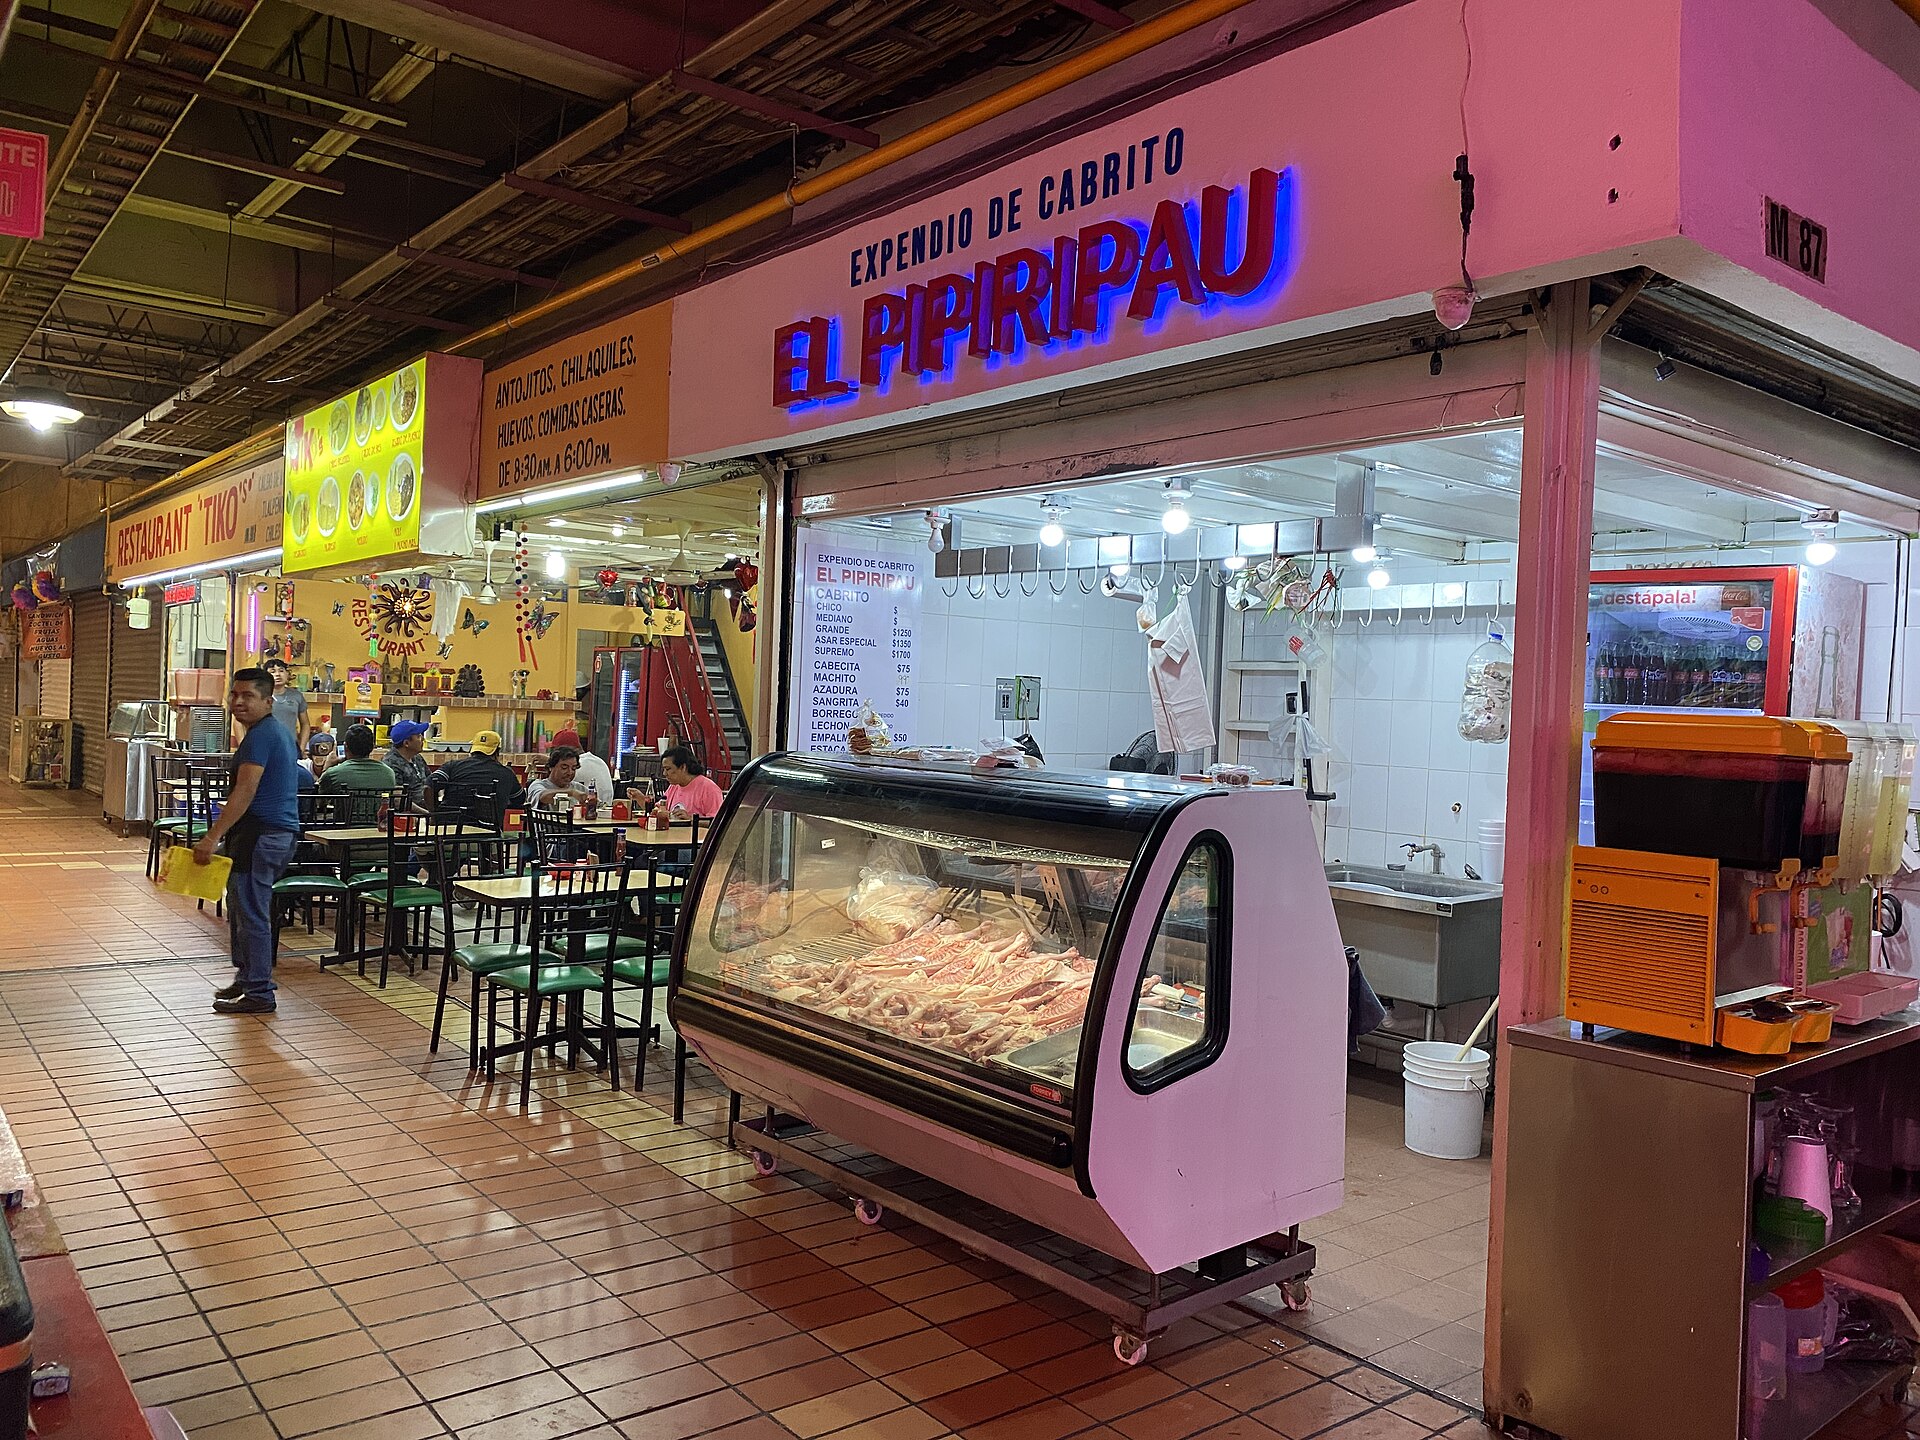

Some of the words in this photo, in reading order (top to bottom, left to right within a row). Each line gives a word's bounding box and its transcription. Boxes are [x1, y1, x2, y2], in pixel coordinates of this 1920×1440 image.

[0, 141, 36, 168] TE
[849, 206, 972, 287] EXPENDIO
[988, 188, 1023, 239] DE
[1038, 127, 1185, 220] CABRITO
[1769, 201, 1789, 262] M
[1799, 219, 1823, 277] 87
[773, 315, 857, 408] EL
[860, 167, 1282, 386] PIPIRIPAU
[538, 400, 580, 437] COMIDAS
[498, 460, 511, 488] DE
[554, 453, 561, 475] A
[117, 503, 193, 568] RESTAURANT
[818, 554, 862, 567] EXPENDIO
[864, 559, 876, 568] DE
[878, 560, 915, 572] CABRITO
[816, 566, 837, 583] EL
[842, 569, 915, 591] PIPIRIPAU
[816, 588, 870, 602] CABRITO
[816, 602, 842, 612] CHICO
[893, 606, 898, 615] $
[816, 613, 853, 624] MEDIANO
[893, 617, 898, 626] $
[815, 624, 850, 635] GRANDE
[892, 628, 912, 638] $1250
[815, 635, 838, 645] ASAR
[840, 637, 877, 648] ESPECIAL
[892, 639, 911, 648] $1350
[815, 646, 855, 657] SUPREMO
[891, 650, 911, 659] $1700
[814, 660, 861, 672] CABECITA
[897, 664, 911, 673] $75
[813, 673, 856, 683] MACHITO
[812, 685, 858, 695] AZADURA
[895, 687, 910, 696] $75
[812, 697, 860, 708] SANGRITA
[895, 699, 909, 707] $40
[893, 733, 908, 742] $50
